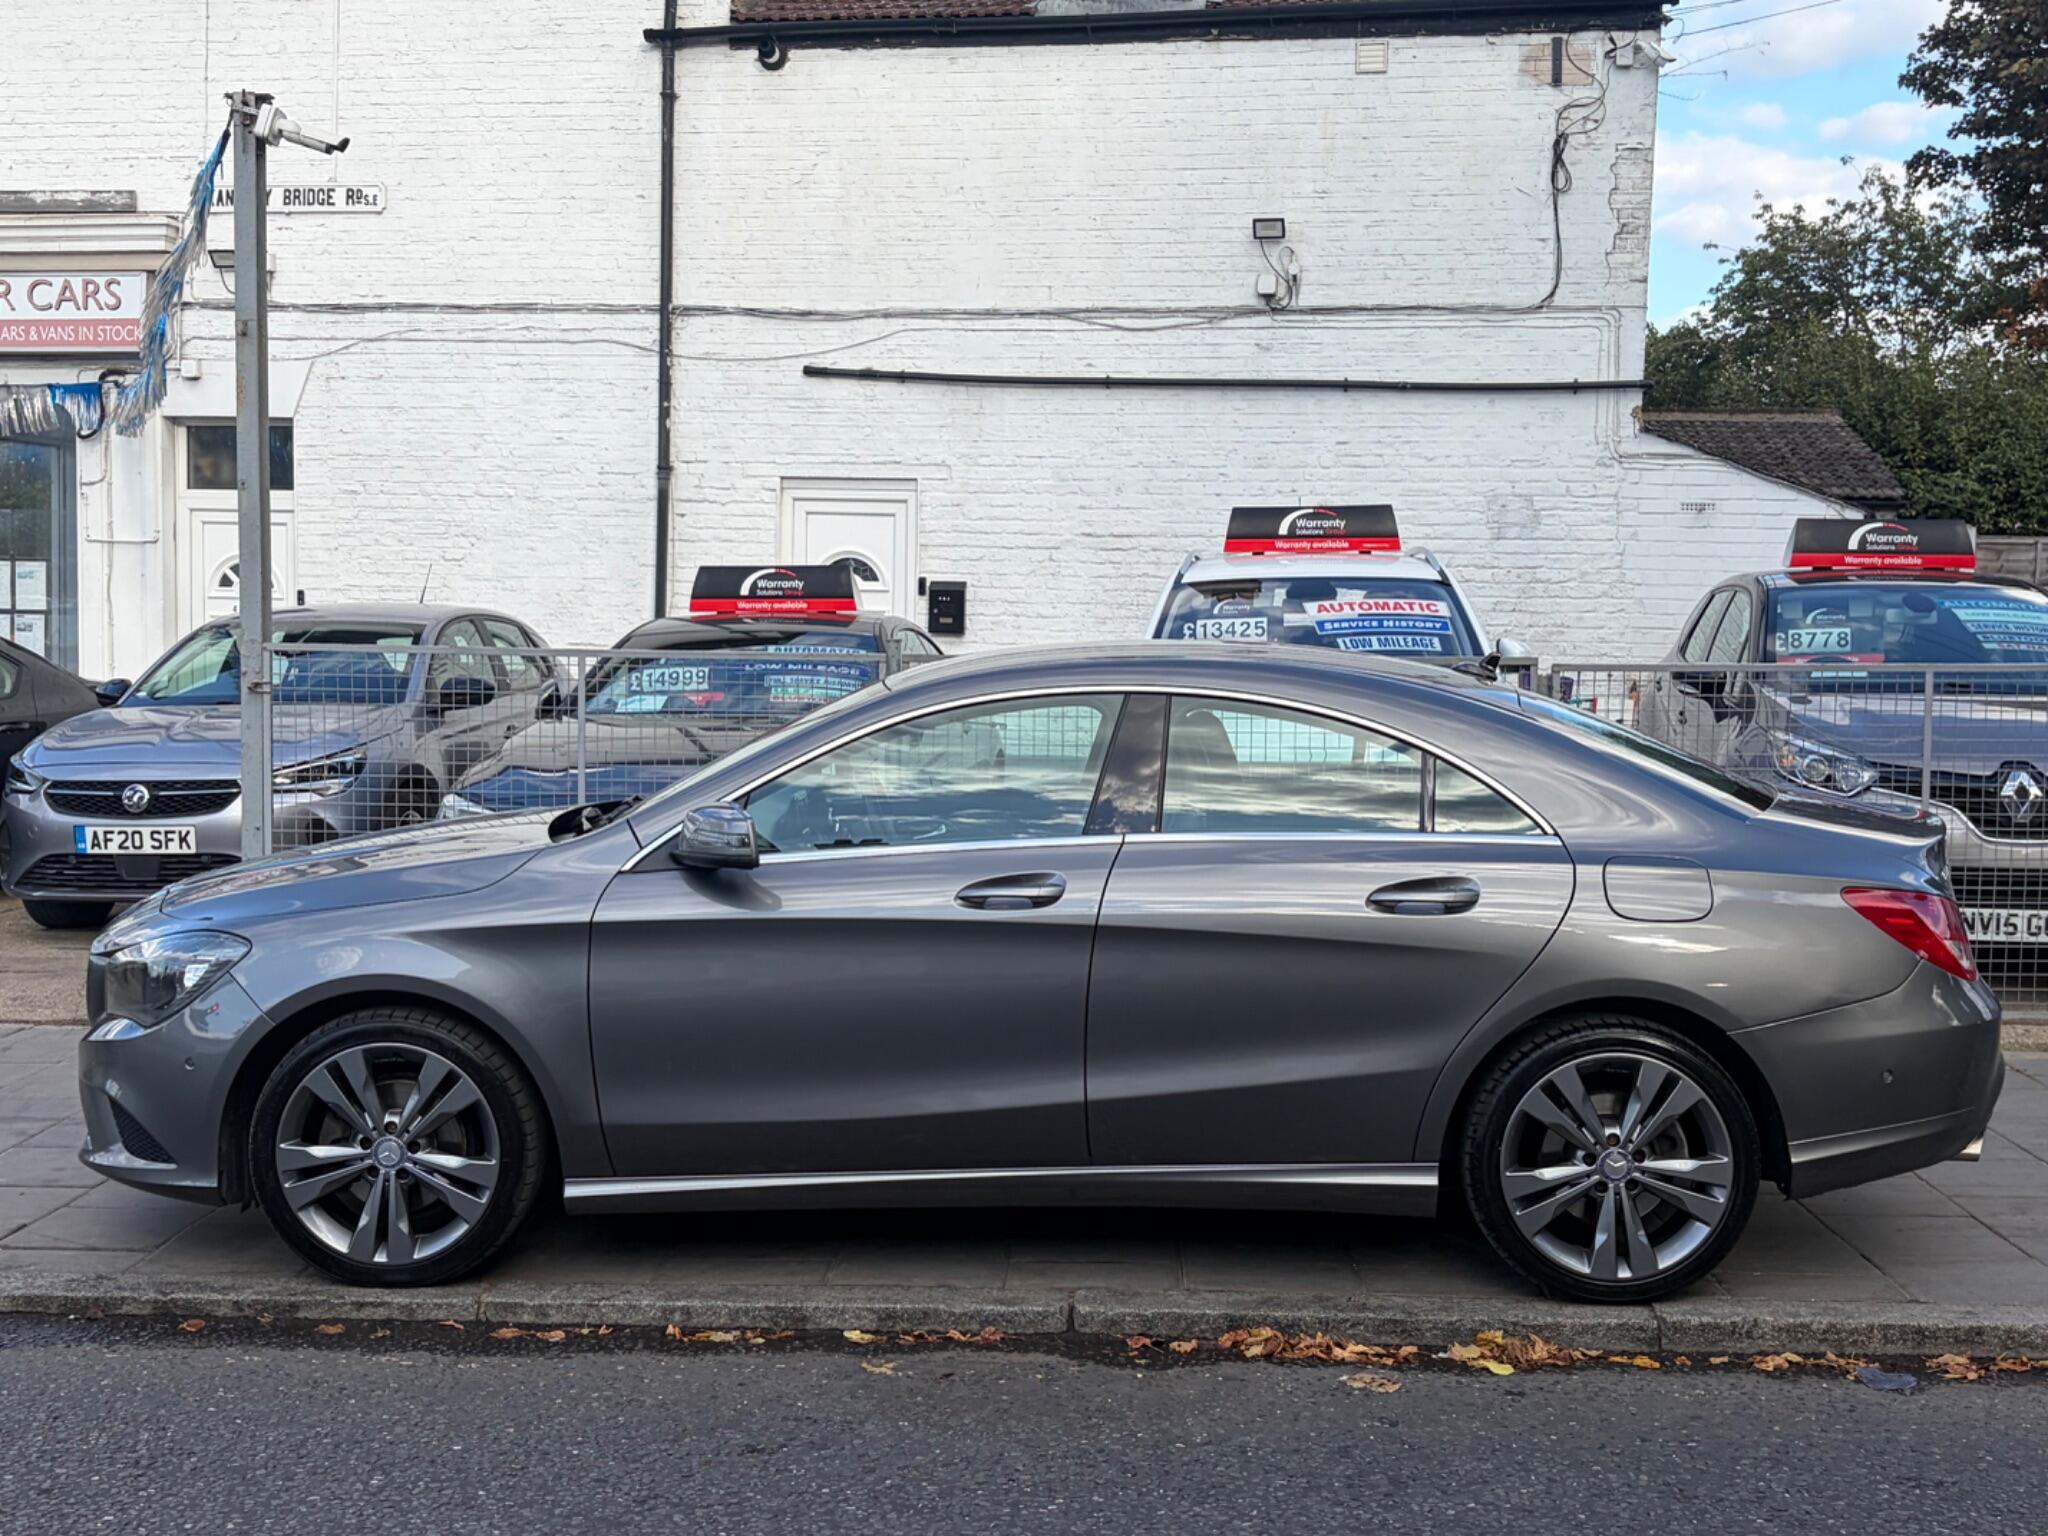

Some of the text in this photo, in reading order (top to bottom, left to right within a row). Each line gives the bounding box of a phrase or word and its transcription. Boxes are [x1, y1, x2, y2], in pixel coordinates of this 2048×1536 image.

[283, 187, 336, 207] BRIDGE
[27, 278, 122, 311] CARS
[29, 326, 39, 341] &
[40, 326, 75, 341] VANS
[79, 326, 94, 341] IN
[1295, 519, 1346, 530] Warranty
[1274, 540, 1349, 550] Warranty available
[1866, 533, 1918, 546] Warranty
[1844, 555, 1922, 566] Warranty available
[756, 579, 804, 591] Warranty
[737, 601, 808, 610] Warranty available
[1317, 601, 1440, 613] AUTOMATIC
[1343, 637, 1437, 649] LOW MILEAGE
[91, 830, 191, 850] AF20 SFK
[2027, 912, 2048, 937] G
